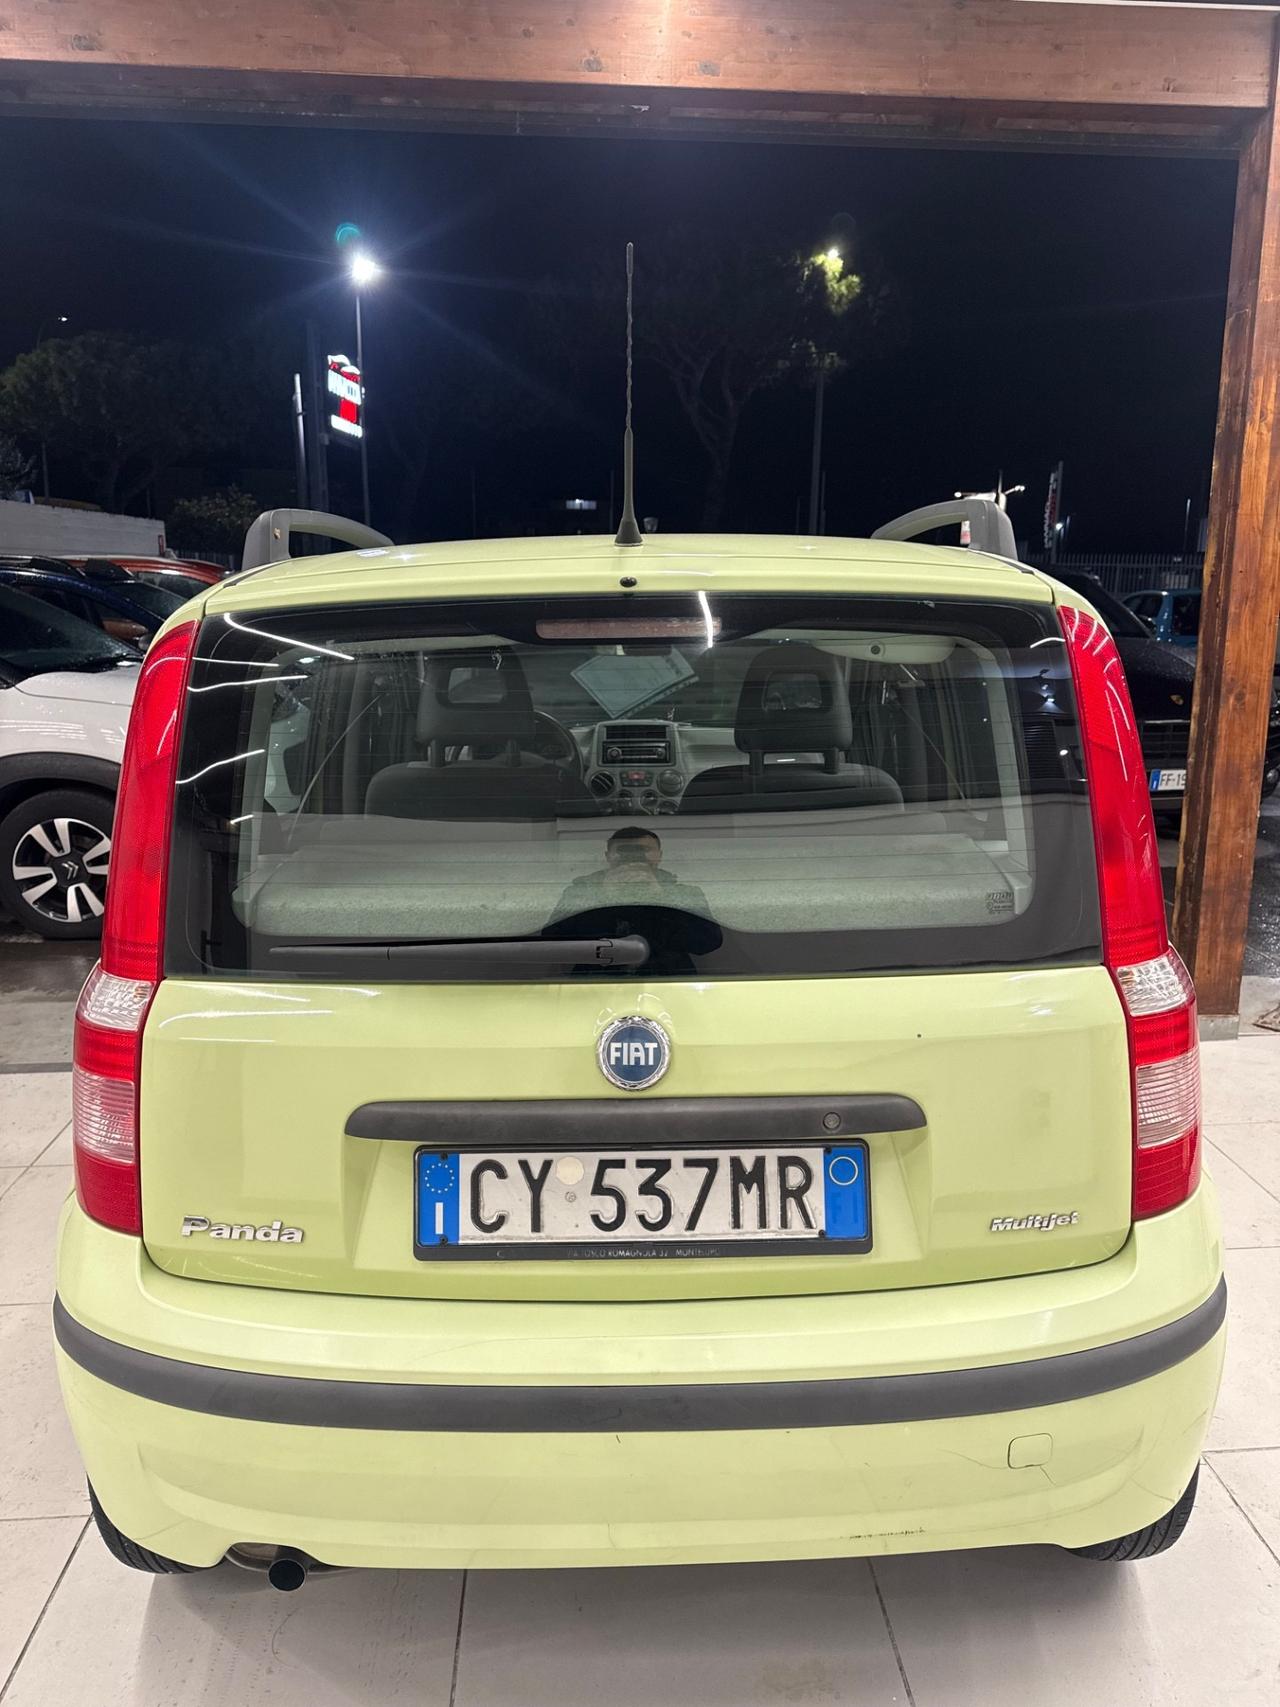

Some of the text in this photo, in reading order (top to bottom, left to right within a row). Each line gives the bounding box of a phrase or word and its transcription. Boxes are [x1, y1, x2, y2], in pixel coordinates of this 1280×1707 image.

[610, 1042, 658, 1066] FIAT
[470, 1155, 818, 1234] CY 537MR
[181, 1215, 304, 1243] Panda
[990, 1211, 1080, 1231] Multijet
